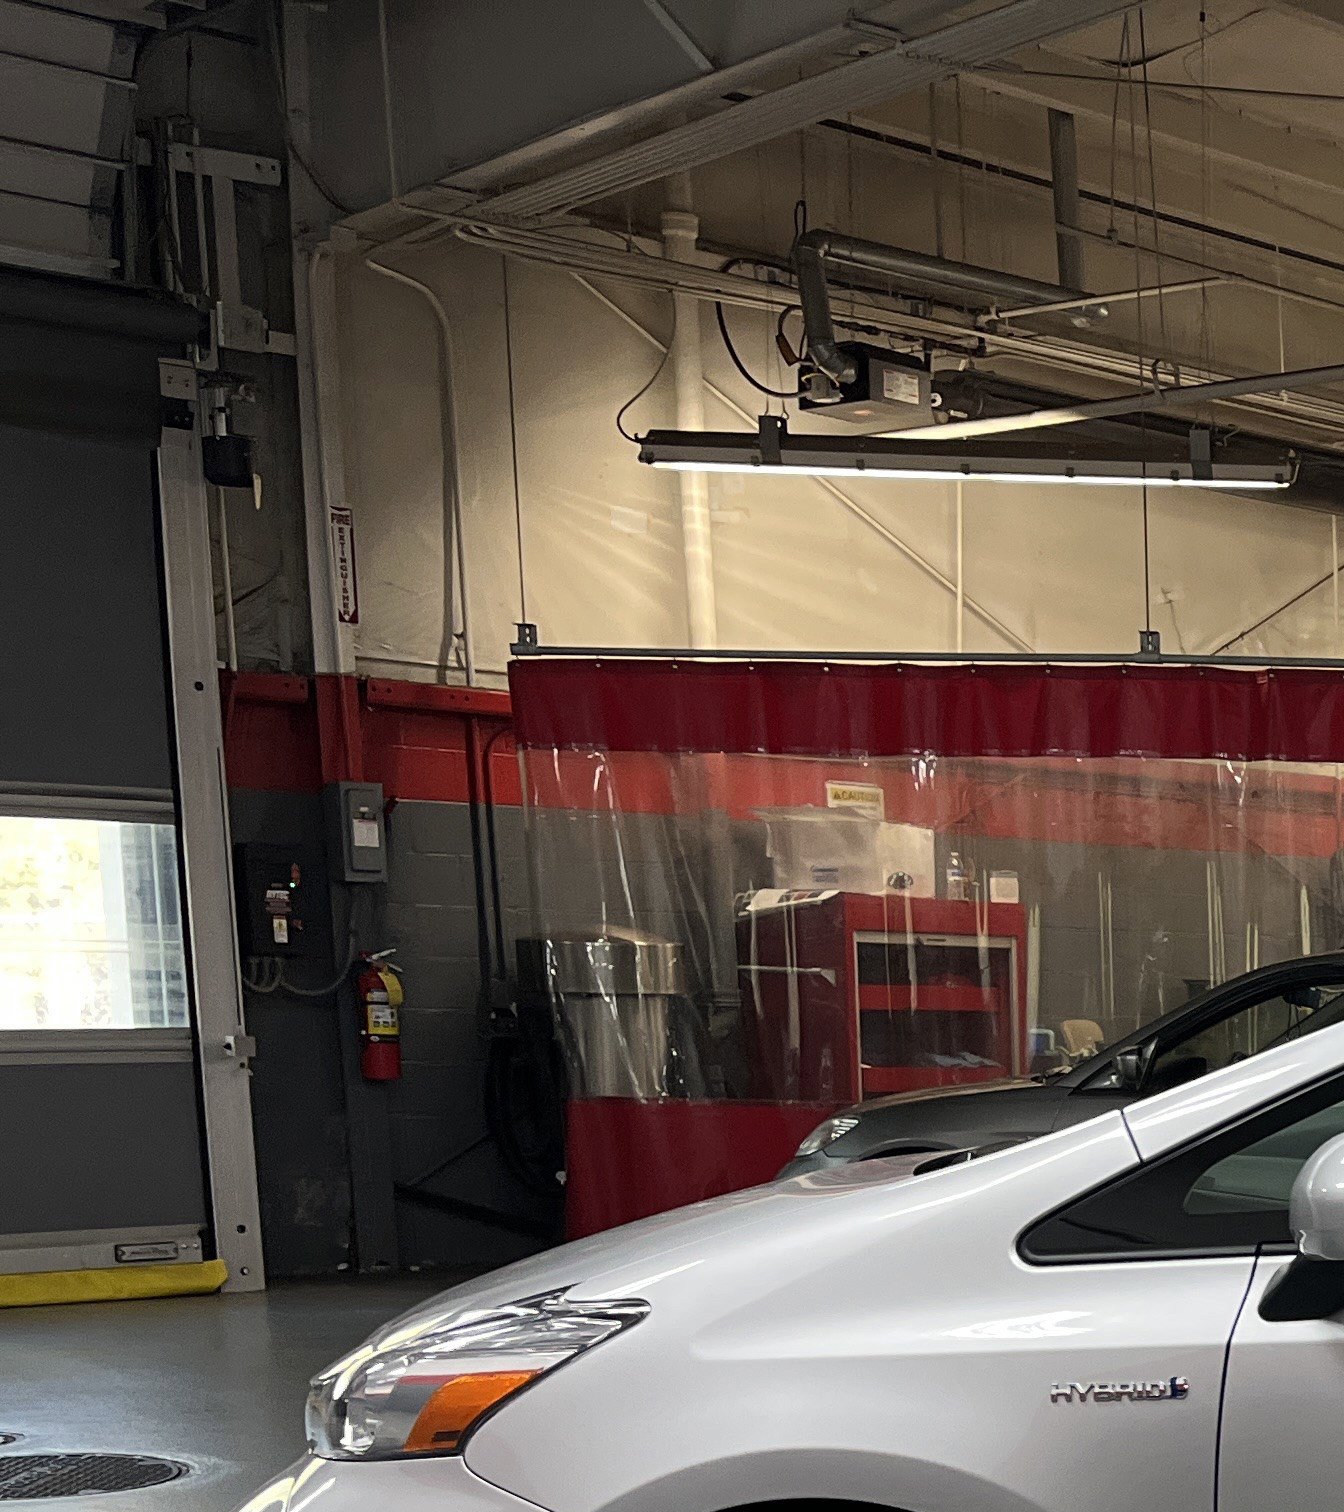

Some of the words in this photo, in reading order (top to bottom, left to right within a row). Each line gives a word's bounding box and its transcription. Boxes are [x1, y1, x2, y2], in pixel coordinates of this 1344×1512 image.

[331, 513, 350, 525] FIRE
[338, 527, 350, 616] EXTINGUISHER
[1050, 1381, 1166, 1403] HYBRID
